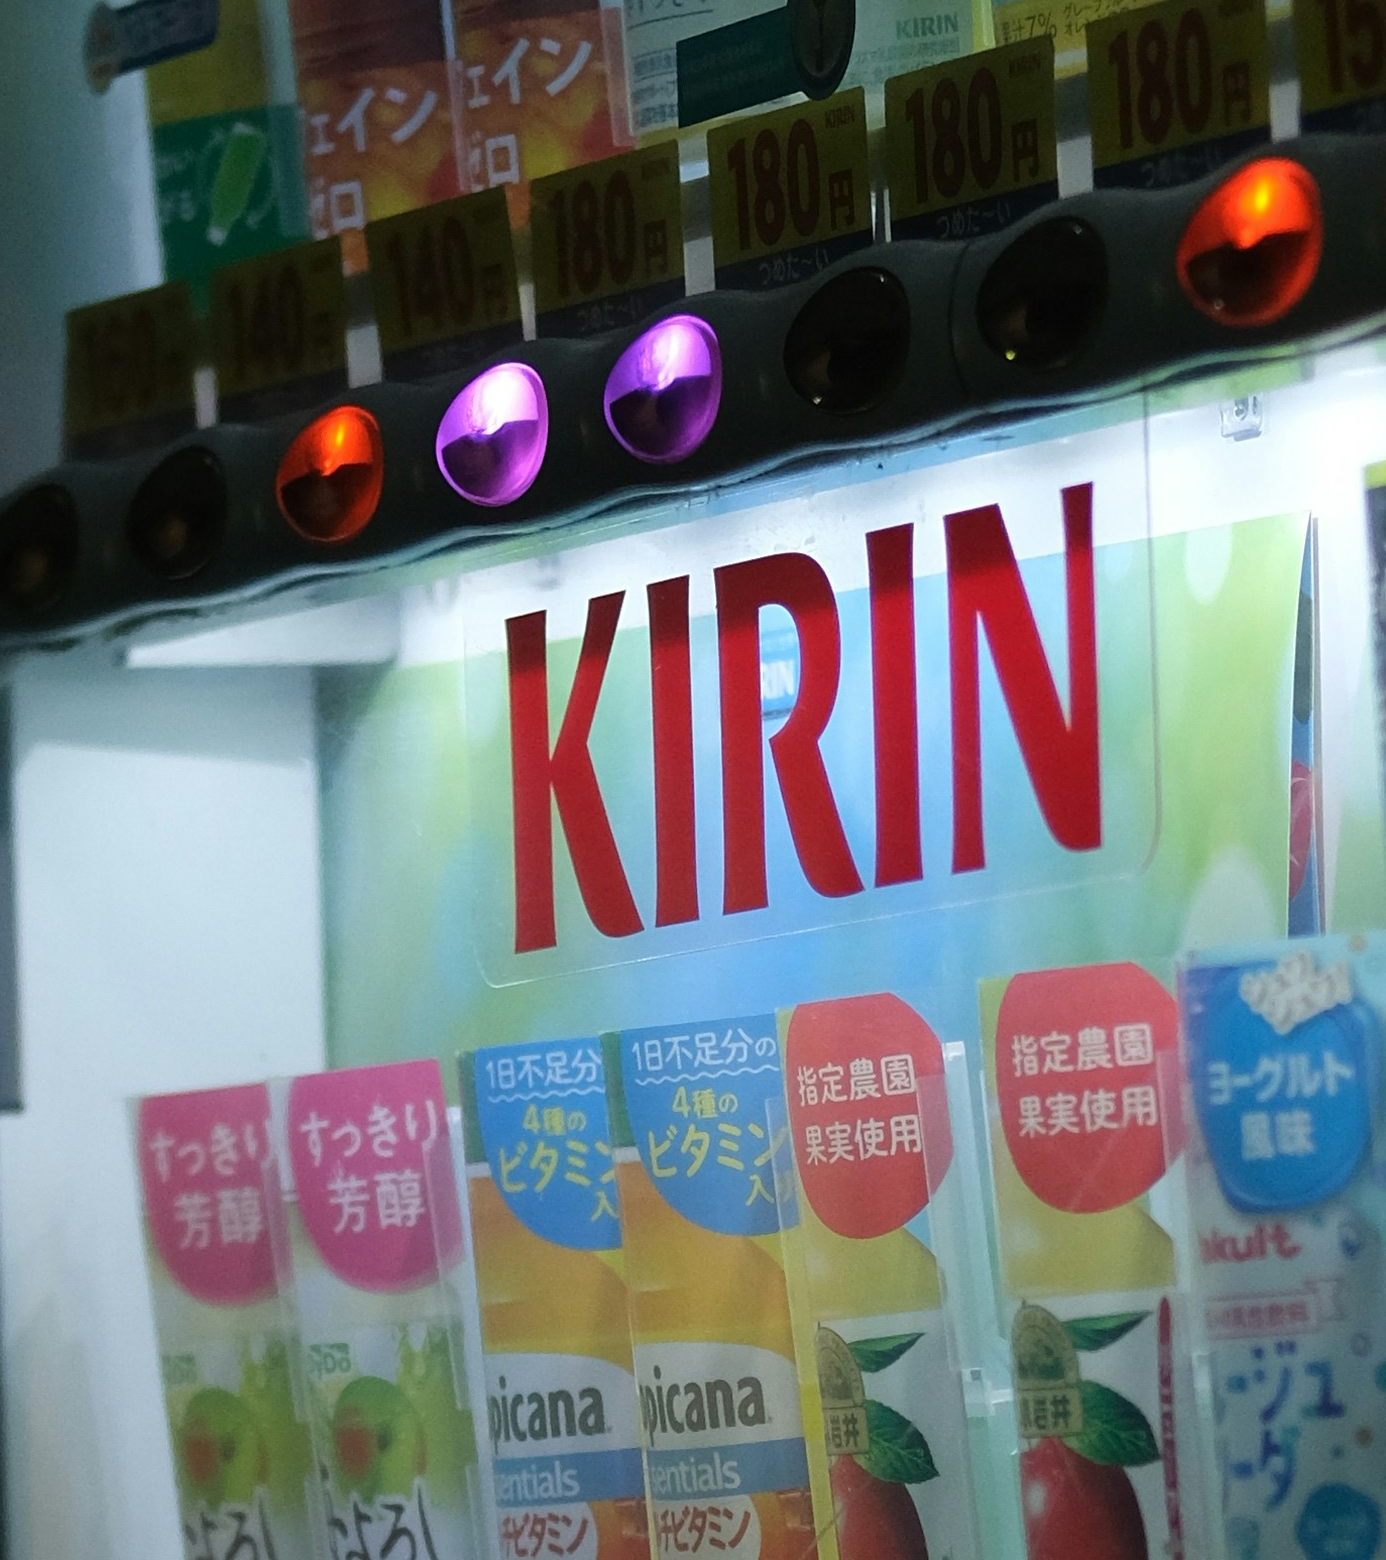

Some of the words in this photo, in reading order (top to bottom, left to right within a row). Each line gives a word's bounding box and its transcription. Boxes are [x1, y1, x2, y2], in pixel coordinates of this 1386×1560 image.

[895, 13, 959, 39] KIRIN
[1009, 52, 1042, 79] KIRIN
[1108, 8, 1252, 153] 180円
[824, 104, 855, 129] KIRIN
[905, 66, 1041, 204] 180円
[727, 118, 855, 251] 180円
[551, 169, 670, 297] 180円
[505, 481, 1103, 954] KIRIN
[631, 1027, 779, 1073] 1日不足分の
[1011, 1023, 1155, 1079] 指定農園
[672, 1085, 739, 1121] 4種の
[796, 1054, 915, 1109] 指定農園
[1206, 1051, 1356, 1105] ヨーグルト
[302, 1099, 440, 1167] すっきり
[521, 1103, 588, 1136] 4種の
[1017, 1086, 1159, 1140] 果実使用
[149, 1118, 273, 1182] すっきり
[648, 1122, 791, 1182] ビタミン
[805, 1114, 923, 1168] 果実使用
[329, 1171, 426, 1235] 芳醇
